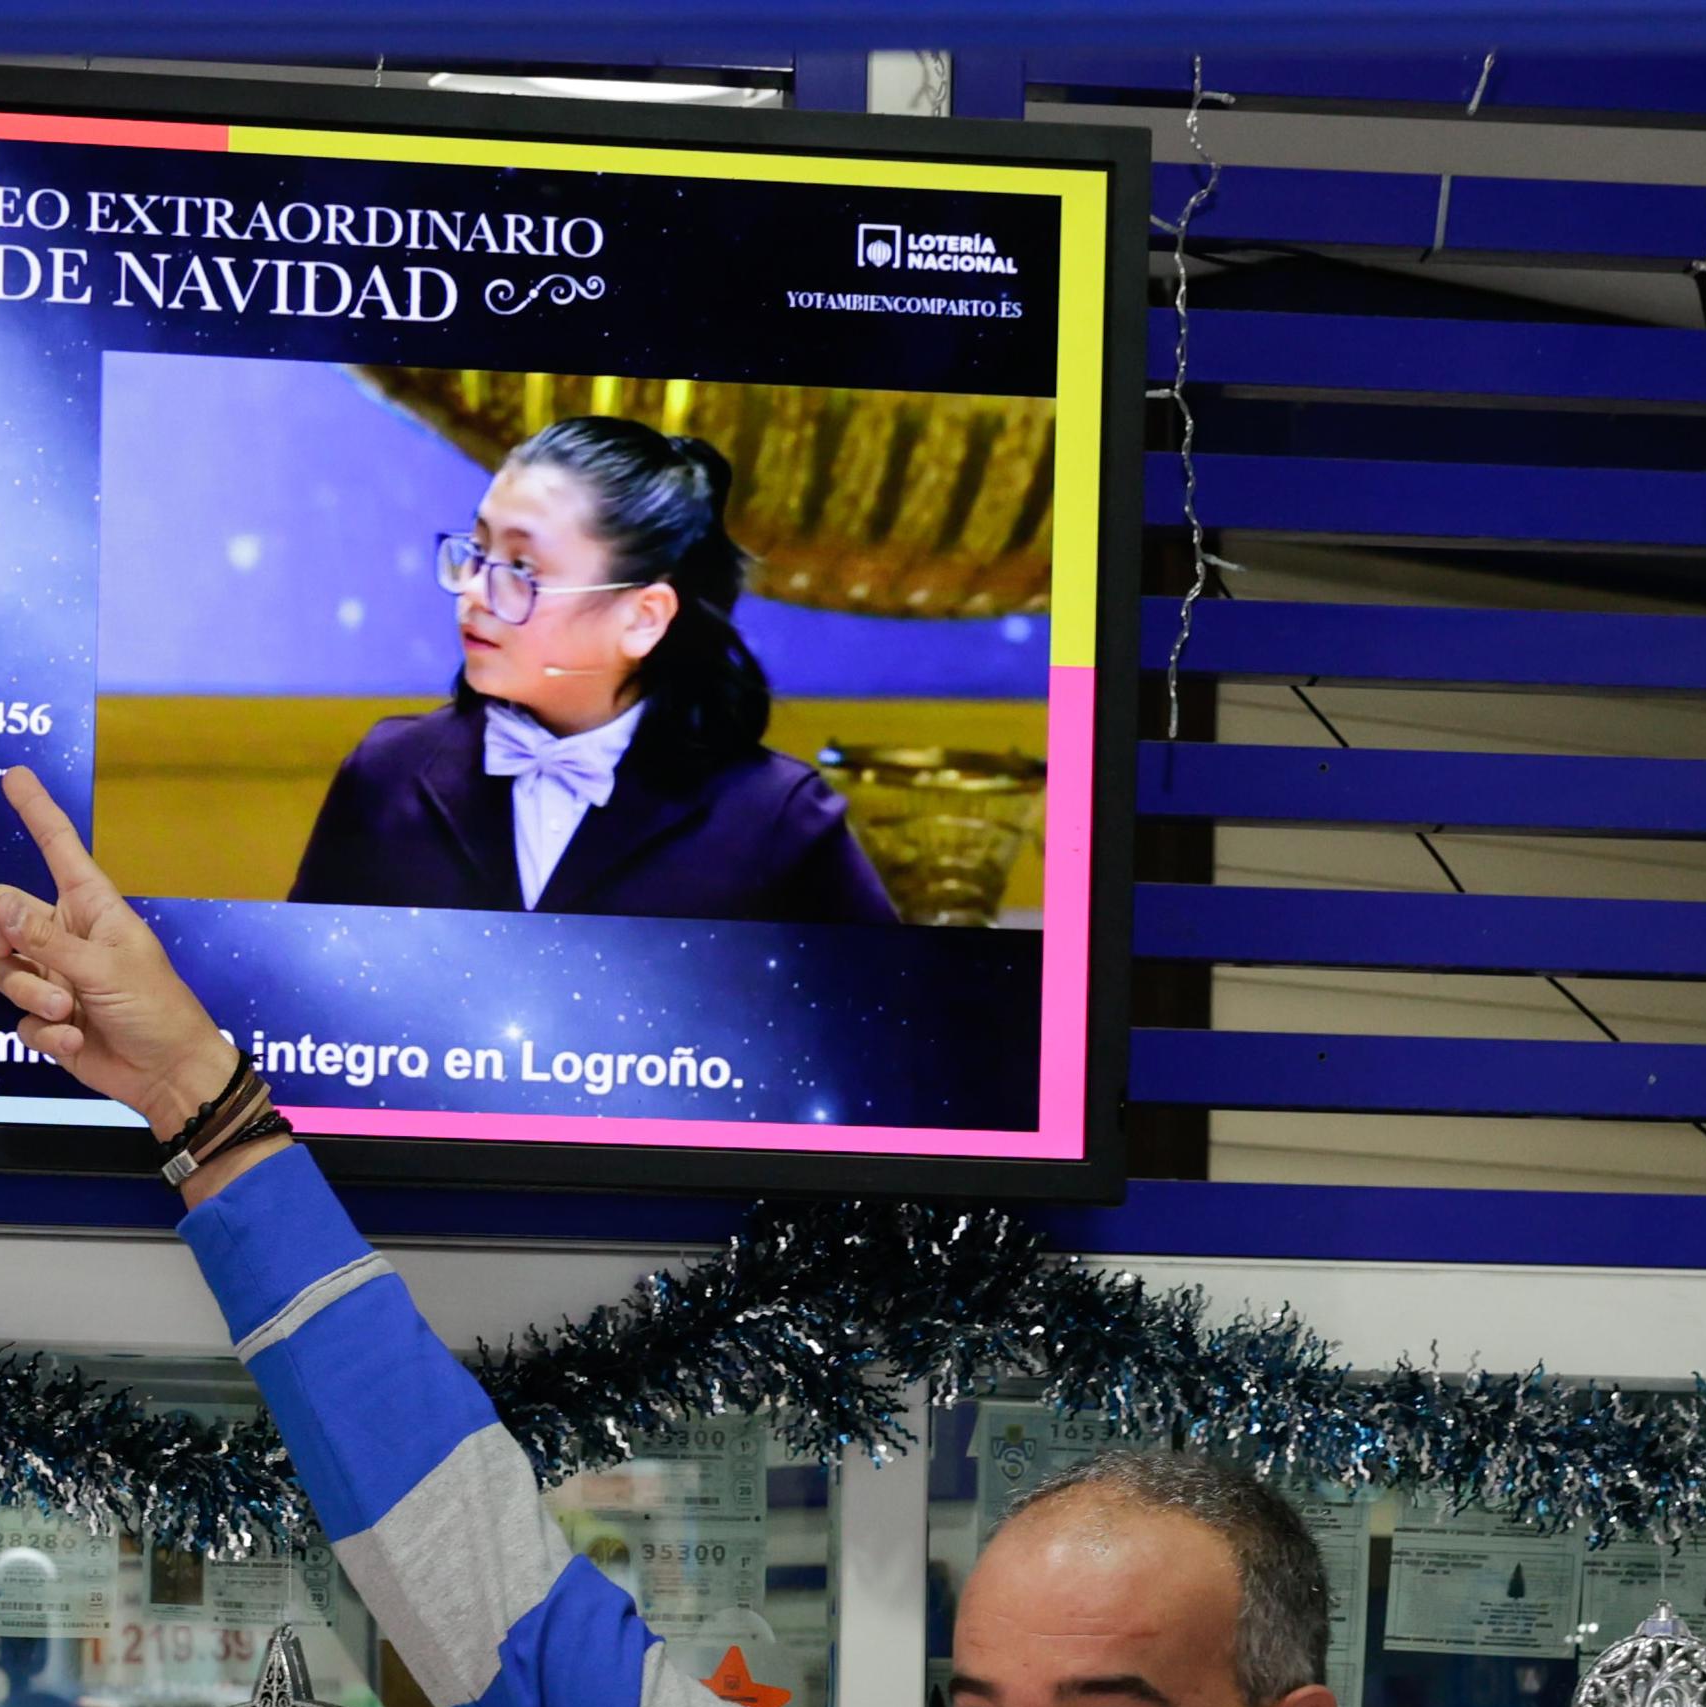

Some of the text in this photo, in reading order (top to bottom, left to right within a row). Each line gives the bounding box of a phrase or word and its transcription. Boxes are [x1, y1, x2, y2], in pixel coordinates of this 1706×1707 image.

[87, 190, 606, 259] EXTRAORDINARIO
[908, 233, 996, 254] LOTERÍA
[908, 253, 1018, 274] NACIONAL
[113, 251, 460, 323] NAVIDAD
[787, 290, 1022, 318] YOTAMBIENCOMPARTO.ES
[444, 1046, 504, 1080] en
[521, 1041, 744, 1095] Logroño.
[643, 1543, 726, 1562] 35300
